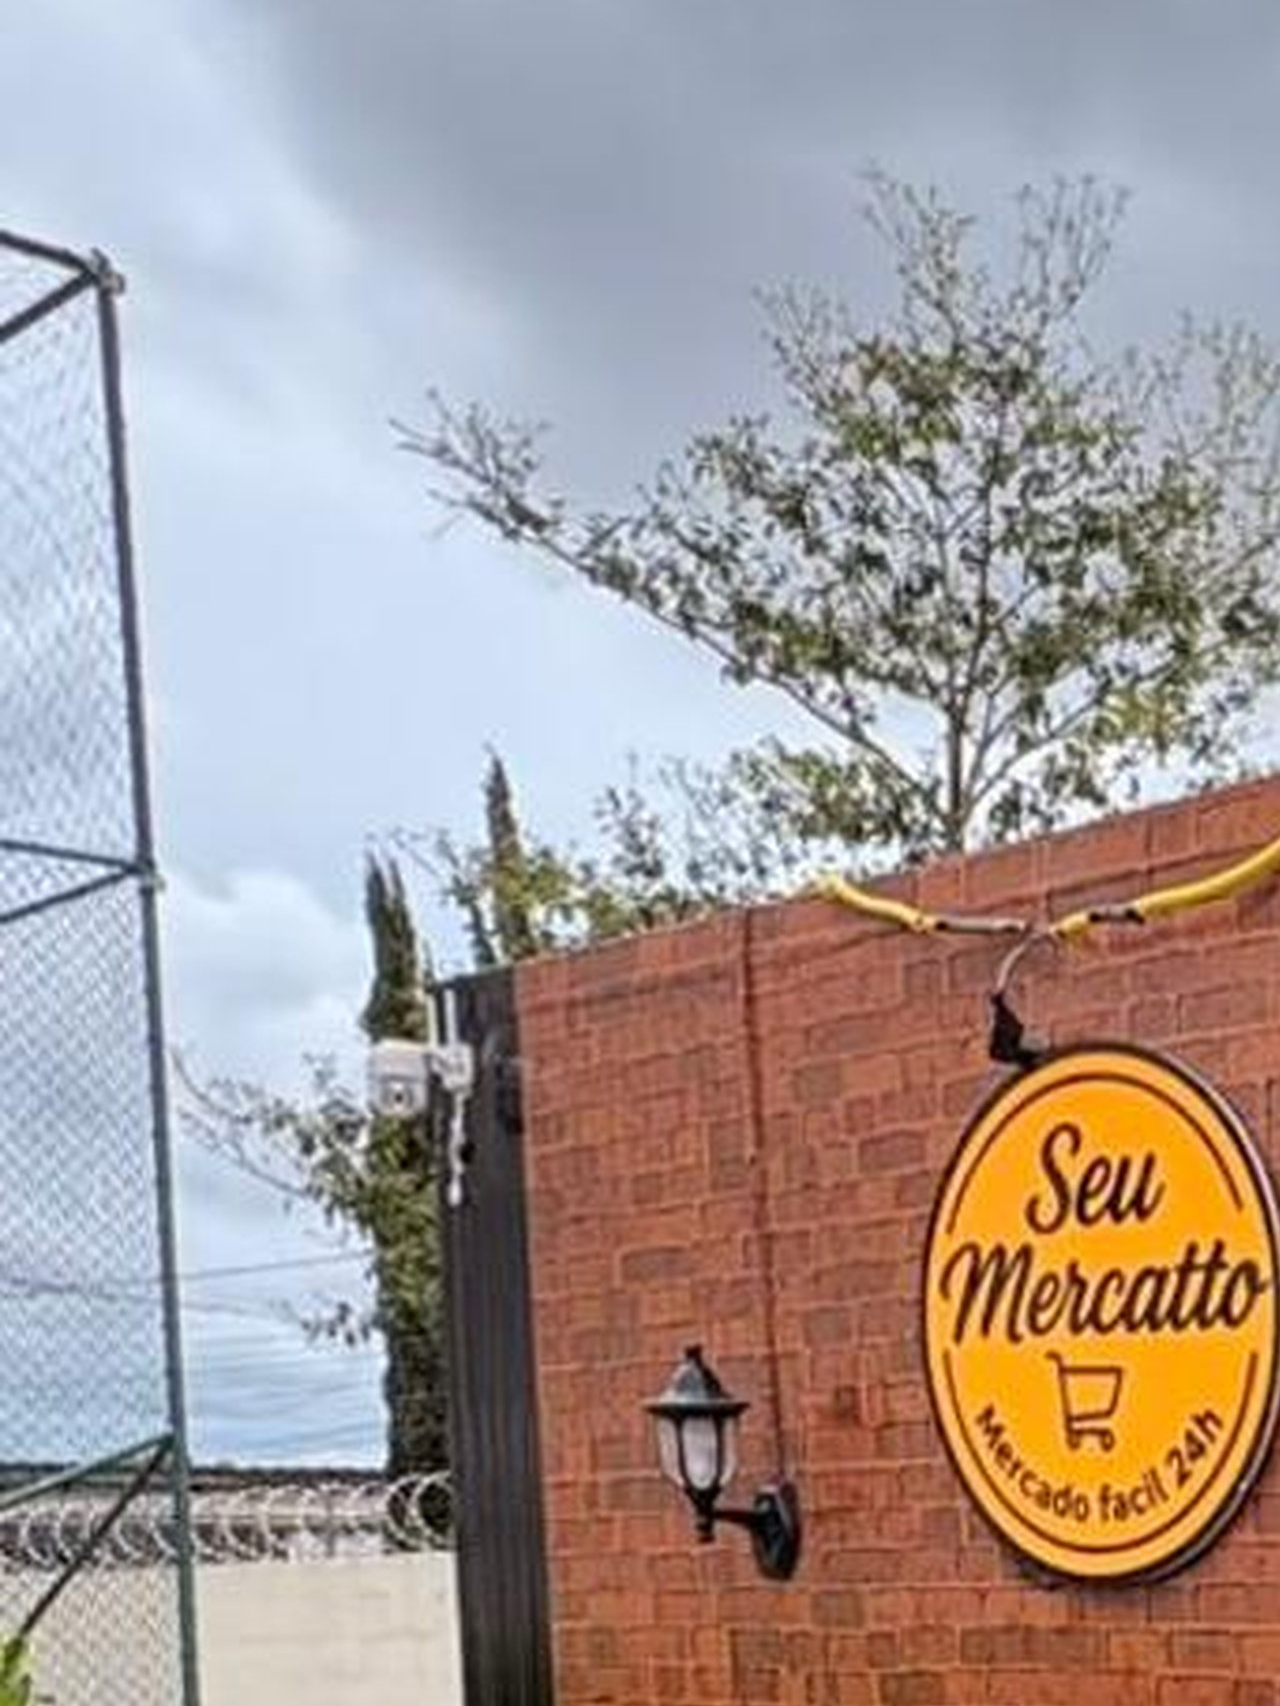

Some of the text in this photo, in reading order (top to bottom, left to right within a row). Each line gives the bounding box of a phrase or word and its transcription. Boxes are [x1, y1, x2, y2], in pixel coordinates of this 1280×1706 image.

[1025, 1122, 1165, 1235] Seu
[940, 1239, 1269, 1345] Mercatto
[976, 1404, 1088, 1522] Mercado
[1166, 1409, 1223, 1487] 24h
